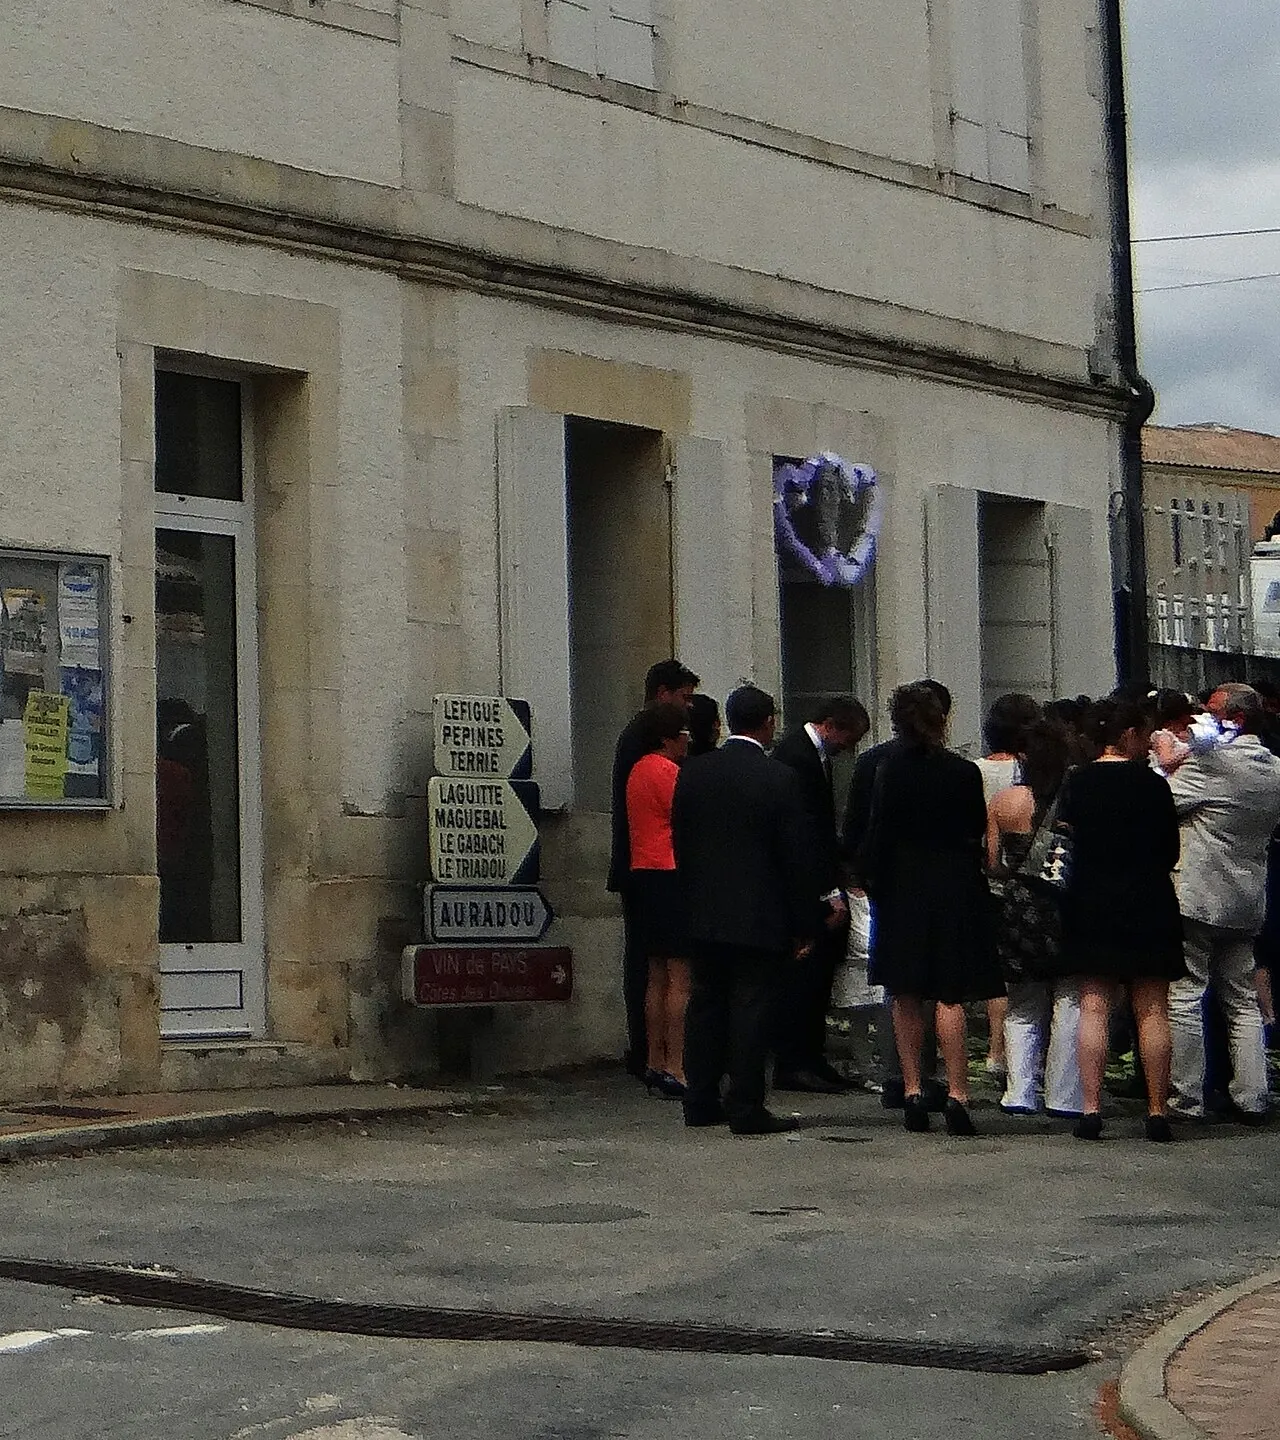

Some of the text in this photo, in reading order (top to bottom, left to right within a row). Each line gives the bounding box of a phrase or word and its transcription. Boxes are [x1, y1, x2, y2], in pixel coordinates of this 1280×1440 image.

[442, 726, 504, 747] PEPINES
[439, 783, 503, 805] LAGUITTE
[440, 833, 454, 853] LE
[438, 857, 506, 879] LE TRIADOU
[440, 901, 534, 928] AURADOU
